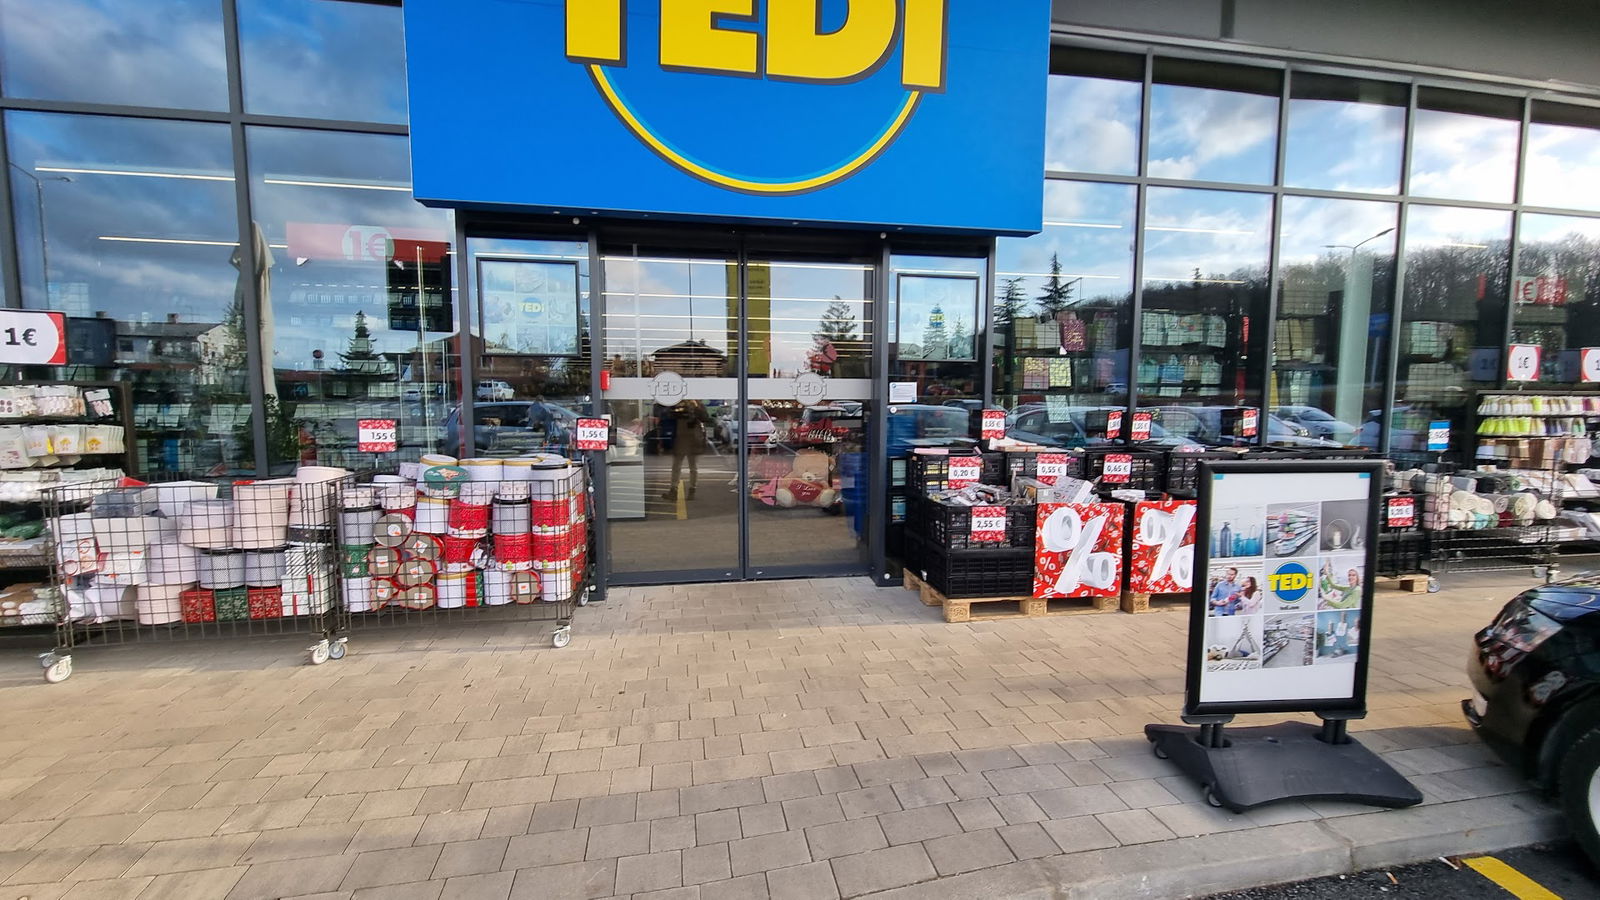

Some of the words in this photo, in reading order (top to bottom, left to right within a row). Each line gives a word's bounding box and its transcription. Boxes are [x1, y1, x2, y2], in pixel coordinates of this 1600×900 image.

[5, 327, 38, 347] 1€
[1517, 356, 1529, 369] 1€
[649, 381, 688, 397] TEDi
[790, 382, 828, 397] TEDi
[581, 430, 598, 439] 1,55
[953, 469, 969, 478] 0,20
[970, 469, 976, 477] €
[1041, 465, 1056, 474] 0,55
[1106, 464, 1122, 473] 0,65
[976, 520, 994, 530] 2,55
[995, 520, 1001, 528] €
[1266, 572, 1314, 592] TEDi
